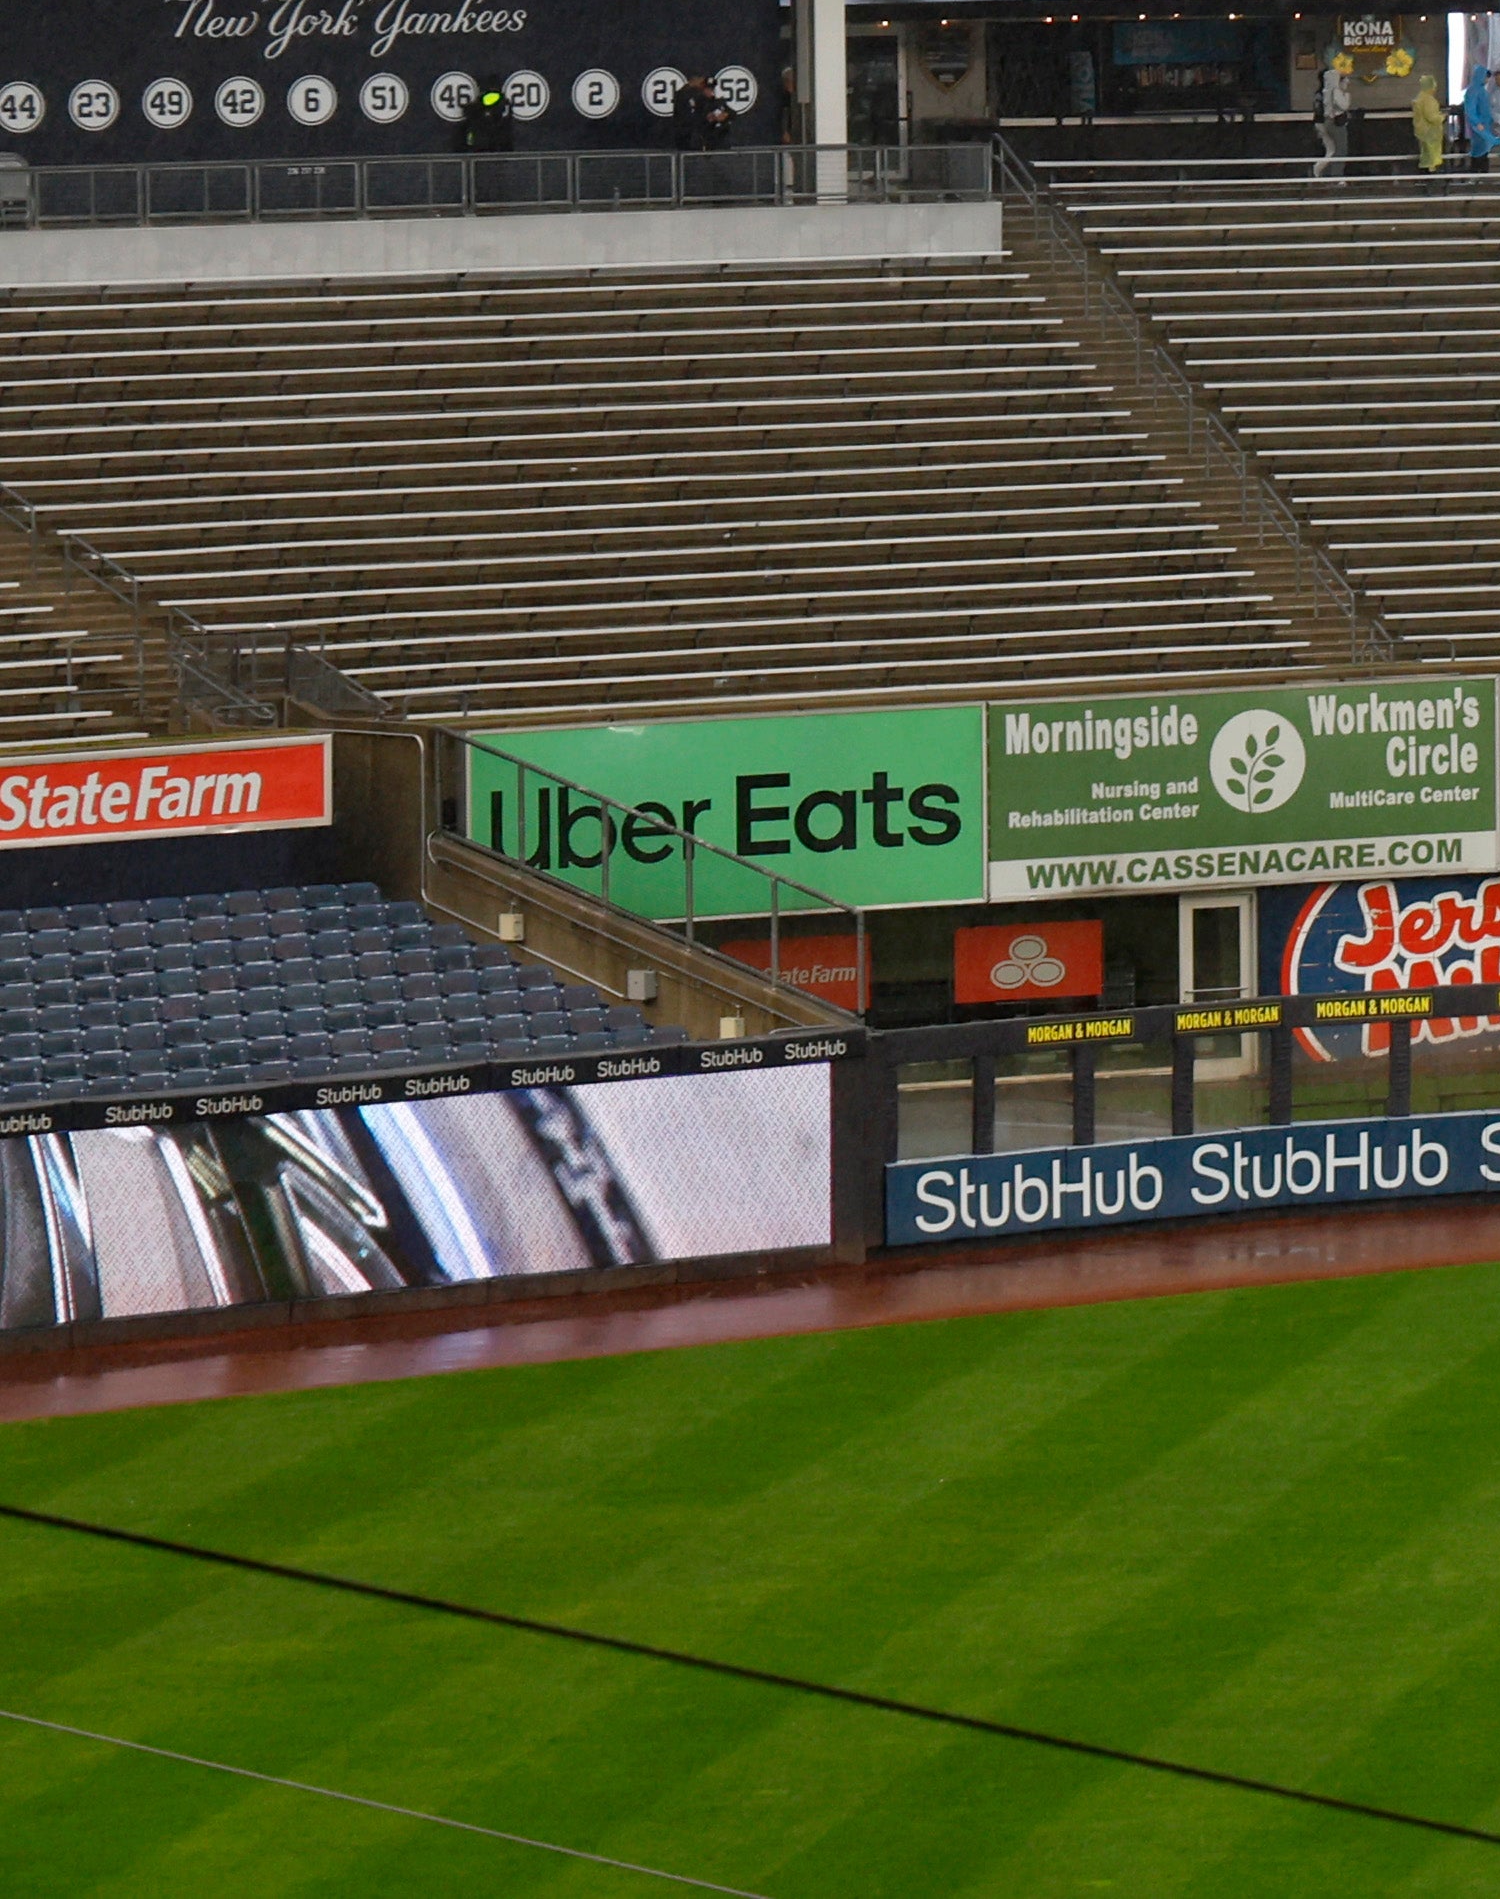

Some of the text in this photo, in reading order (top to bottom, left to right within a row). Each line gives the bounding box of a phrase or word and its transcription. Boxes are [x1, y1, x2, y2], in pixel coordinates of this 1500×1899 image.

[1343, 20, 1394, 36] KONA
[1343, 36, 1395, 46] BIG WAVE
[2, 78, 749, 120] 44 23 49 42 6 51 46 20 2 21 52
[1005, 687, 1480, 759] Morningside Workmen's
[1386, 733, 1479, 778] Circle
[1092, 777, 1199, 802] Nursing and
[1329, 784, 1480, 810] MultiCare Center
[490, 771, 961, 870] Uber Eats
[1008, 802, 1199, 830] Rehabilitation Center
[1026, 838, 1463, 889] WWW.CASSENACARE.COM
[1317, 997, 1429, 1018] MORGAN & MORGAN
[1029, 1019, 1131, 1042] MORGAN & MORGAN
[105, 1041, 847, 1124] StubHub StubHub StubHub
[915, 1155, 1163, 1234] StubHub
[1191, 1126, 1449, 1205] StubHub
